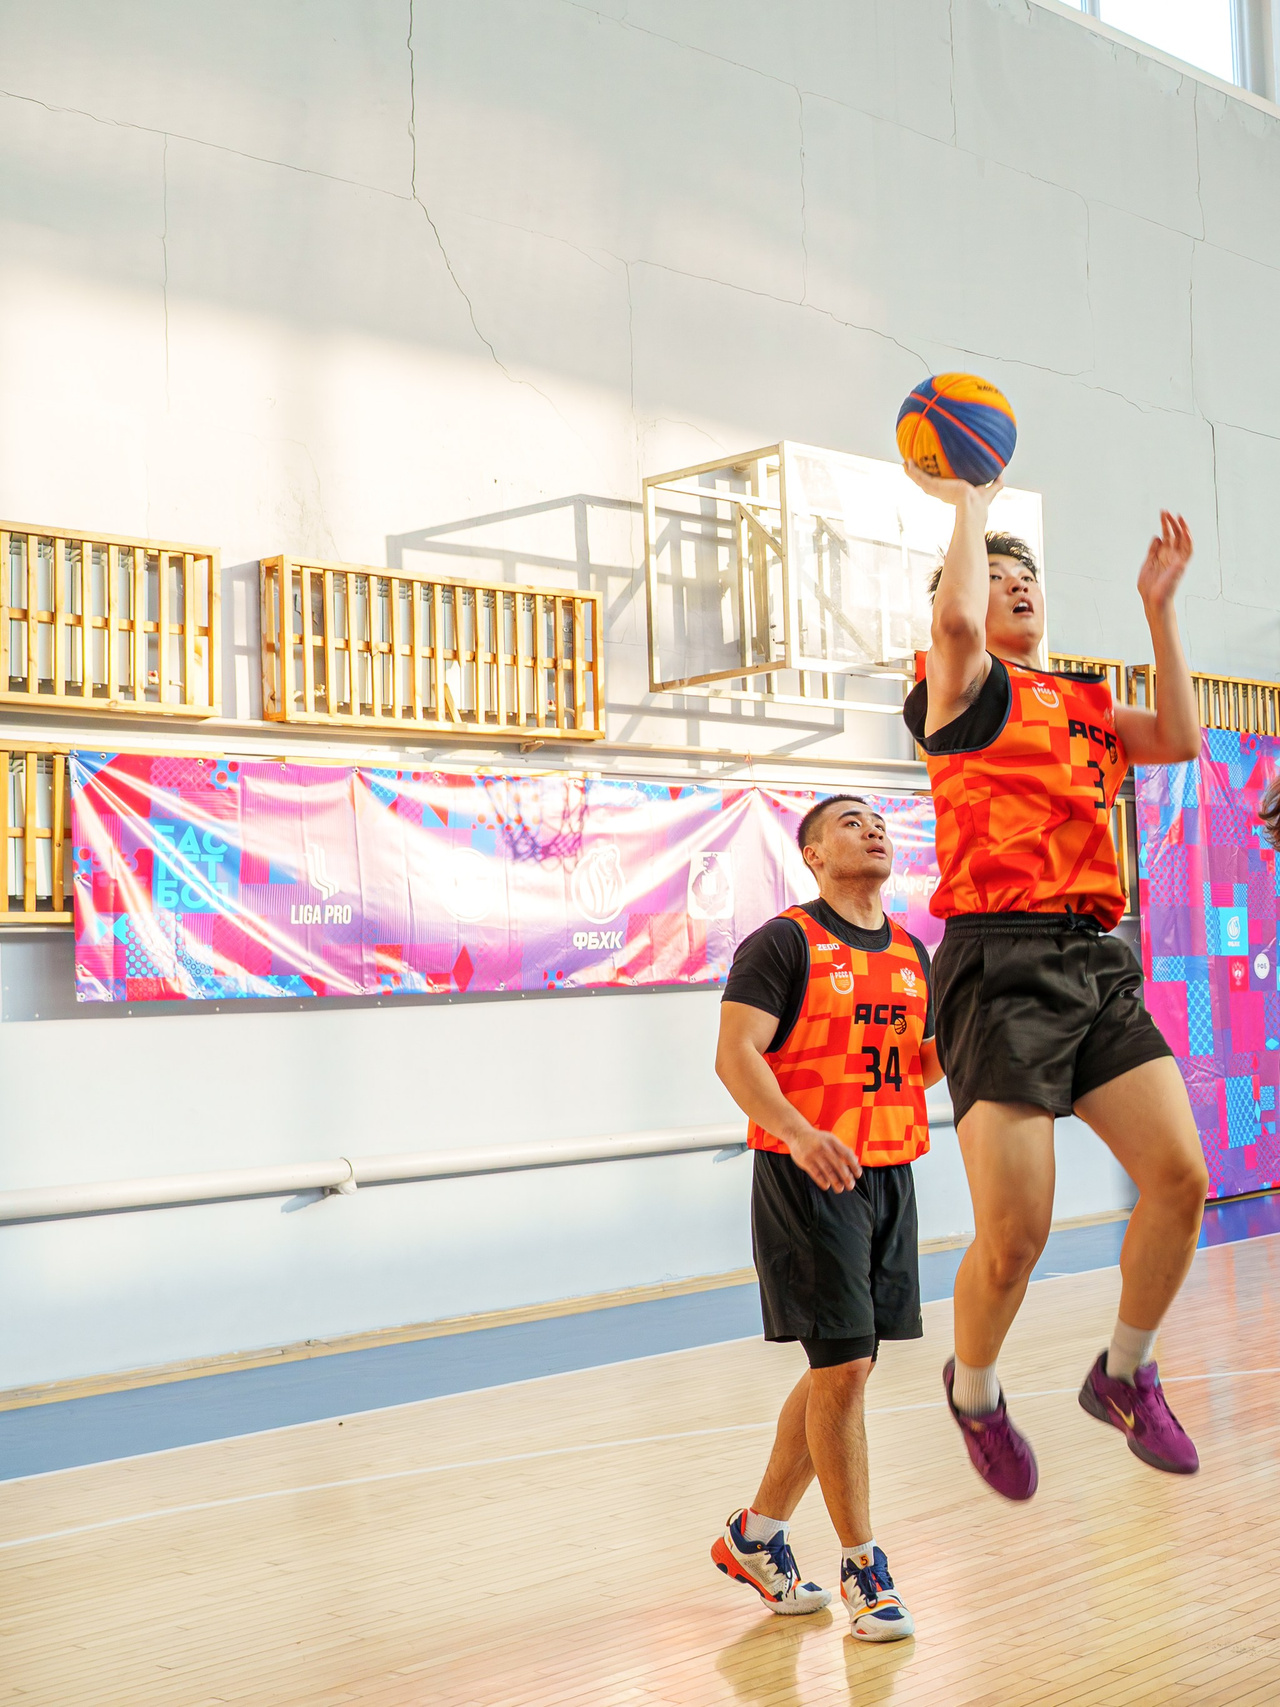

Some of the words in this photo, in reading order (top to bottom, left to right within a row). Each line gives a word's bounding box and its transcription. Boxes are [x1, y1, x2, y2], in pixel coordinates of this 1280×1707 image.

[154, 824, 229, 855] БАС
[290, 904, 323, 925] LIGA
[324, 904, 352, 925] PRO
[572, 931, 624, 951] ФБХК
[854, 1003, 908, 1030] АСБ
[862, 1045, 903, 1092] 34
